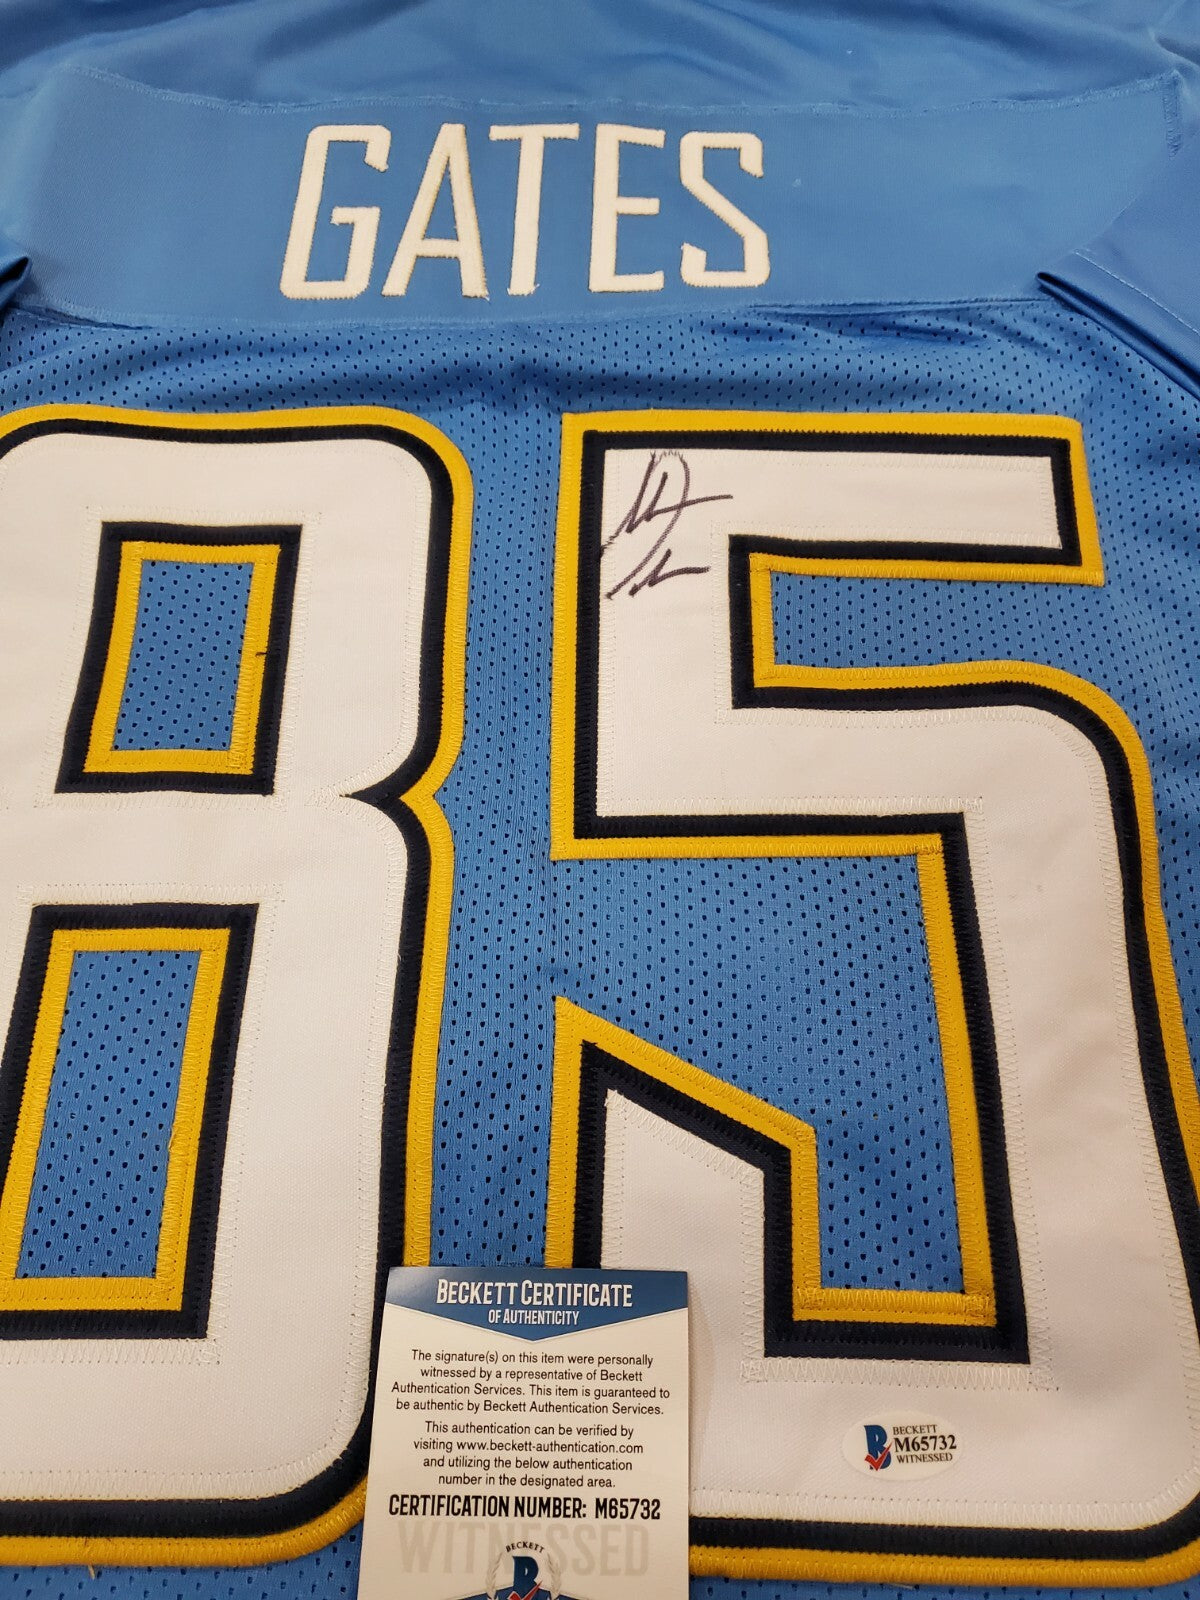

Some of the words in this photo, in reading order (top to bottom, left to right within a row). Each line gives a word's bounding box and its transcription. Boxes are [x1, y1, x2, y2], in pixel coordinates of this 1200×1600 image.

[280, 123, 770, 300] GATES
[0, 404, 1200, 1581] 85
[488, 1309, 501, 1323] OF
[412, 1349, 431, 1361] The
[435, 1350, 498, 1364] signature(s)
[502, 1353, 516, 1362] on
[519, 1352, 538, 1363] this
[541, 1353, 564, 1364] item
[567, 1356, 594, 1364] were
[598, 1354, 653, 1368] personally
[421, 1366, 476, 1378] witnessed
[480, 1368, 492, 1381] by
[495, 1371, 502, 1379] a
[505, 1369, 582, 1382] representative
[586, 1370, 597, 1381] of
[600, 1370, 642, 1381] Beckett
[391, 1382, 470, 1394] Authentication
[474, 1383, 525, 1396] Services.
[529, 1384, 552, 1396] This
[556, 1385, 578, 1397] item
[581, 1387, 591, 1397] is
[594, 1387, 656, 1401] guaranteed
[659, 1388, 670, 1399] to
[396, 1399, 410, 1410] be
[413, 1399, 464, 1411] authentic
[467, 1400, 480, 1414] by
[484, 1400, 526, 1412] Beckett
[529, 1402, 608, 1414] Authentication
[612, 1403, 664, 1415] Services.
[425, 1421, 448, 1433] This
[451, 1422, 531, 1434] authentication
[534, 1425, 555, 1435] can
[559, 1424, 573, 1435] be
[576, 1424, 618, 1437] verified
[620, 1426, 634, 1440] by
[893, 1424, 937, 1435] BECKETT
[413, 1438, 453, 1453] visiting
[456, 1439, 643, 1454] www.beckett-authentication.com
[894, 1435, 957, 1452] M65732
[423, 1456, 444, 1467] and
[448, 1456, 491, 1471] utilizing
[494, 1457, 512, 1469] the
[515, 1458, 550, 1469] below
[553, 1458, 632, 1470] authentication
[896, 1453, 953, 1463] WITNESSED
[438, 1474, 482, 1485] number
[485, 1474, 495, 1485] in
[499, 1474, 516, 1486] the
[520, 1475, 583, 1490] designated
[587, 1478, 616, 1488] area.
[389, 1494, 509, 1517] CERTIFICATION
[514, 1496, 586, 1518] NUMBER:
[595, 1498, 661, 1520] M65732
[399, 1519, 650, 1577] WITNSSED
[505, 1541, 545, 1553] BECKETT
